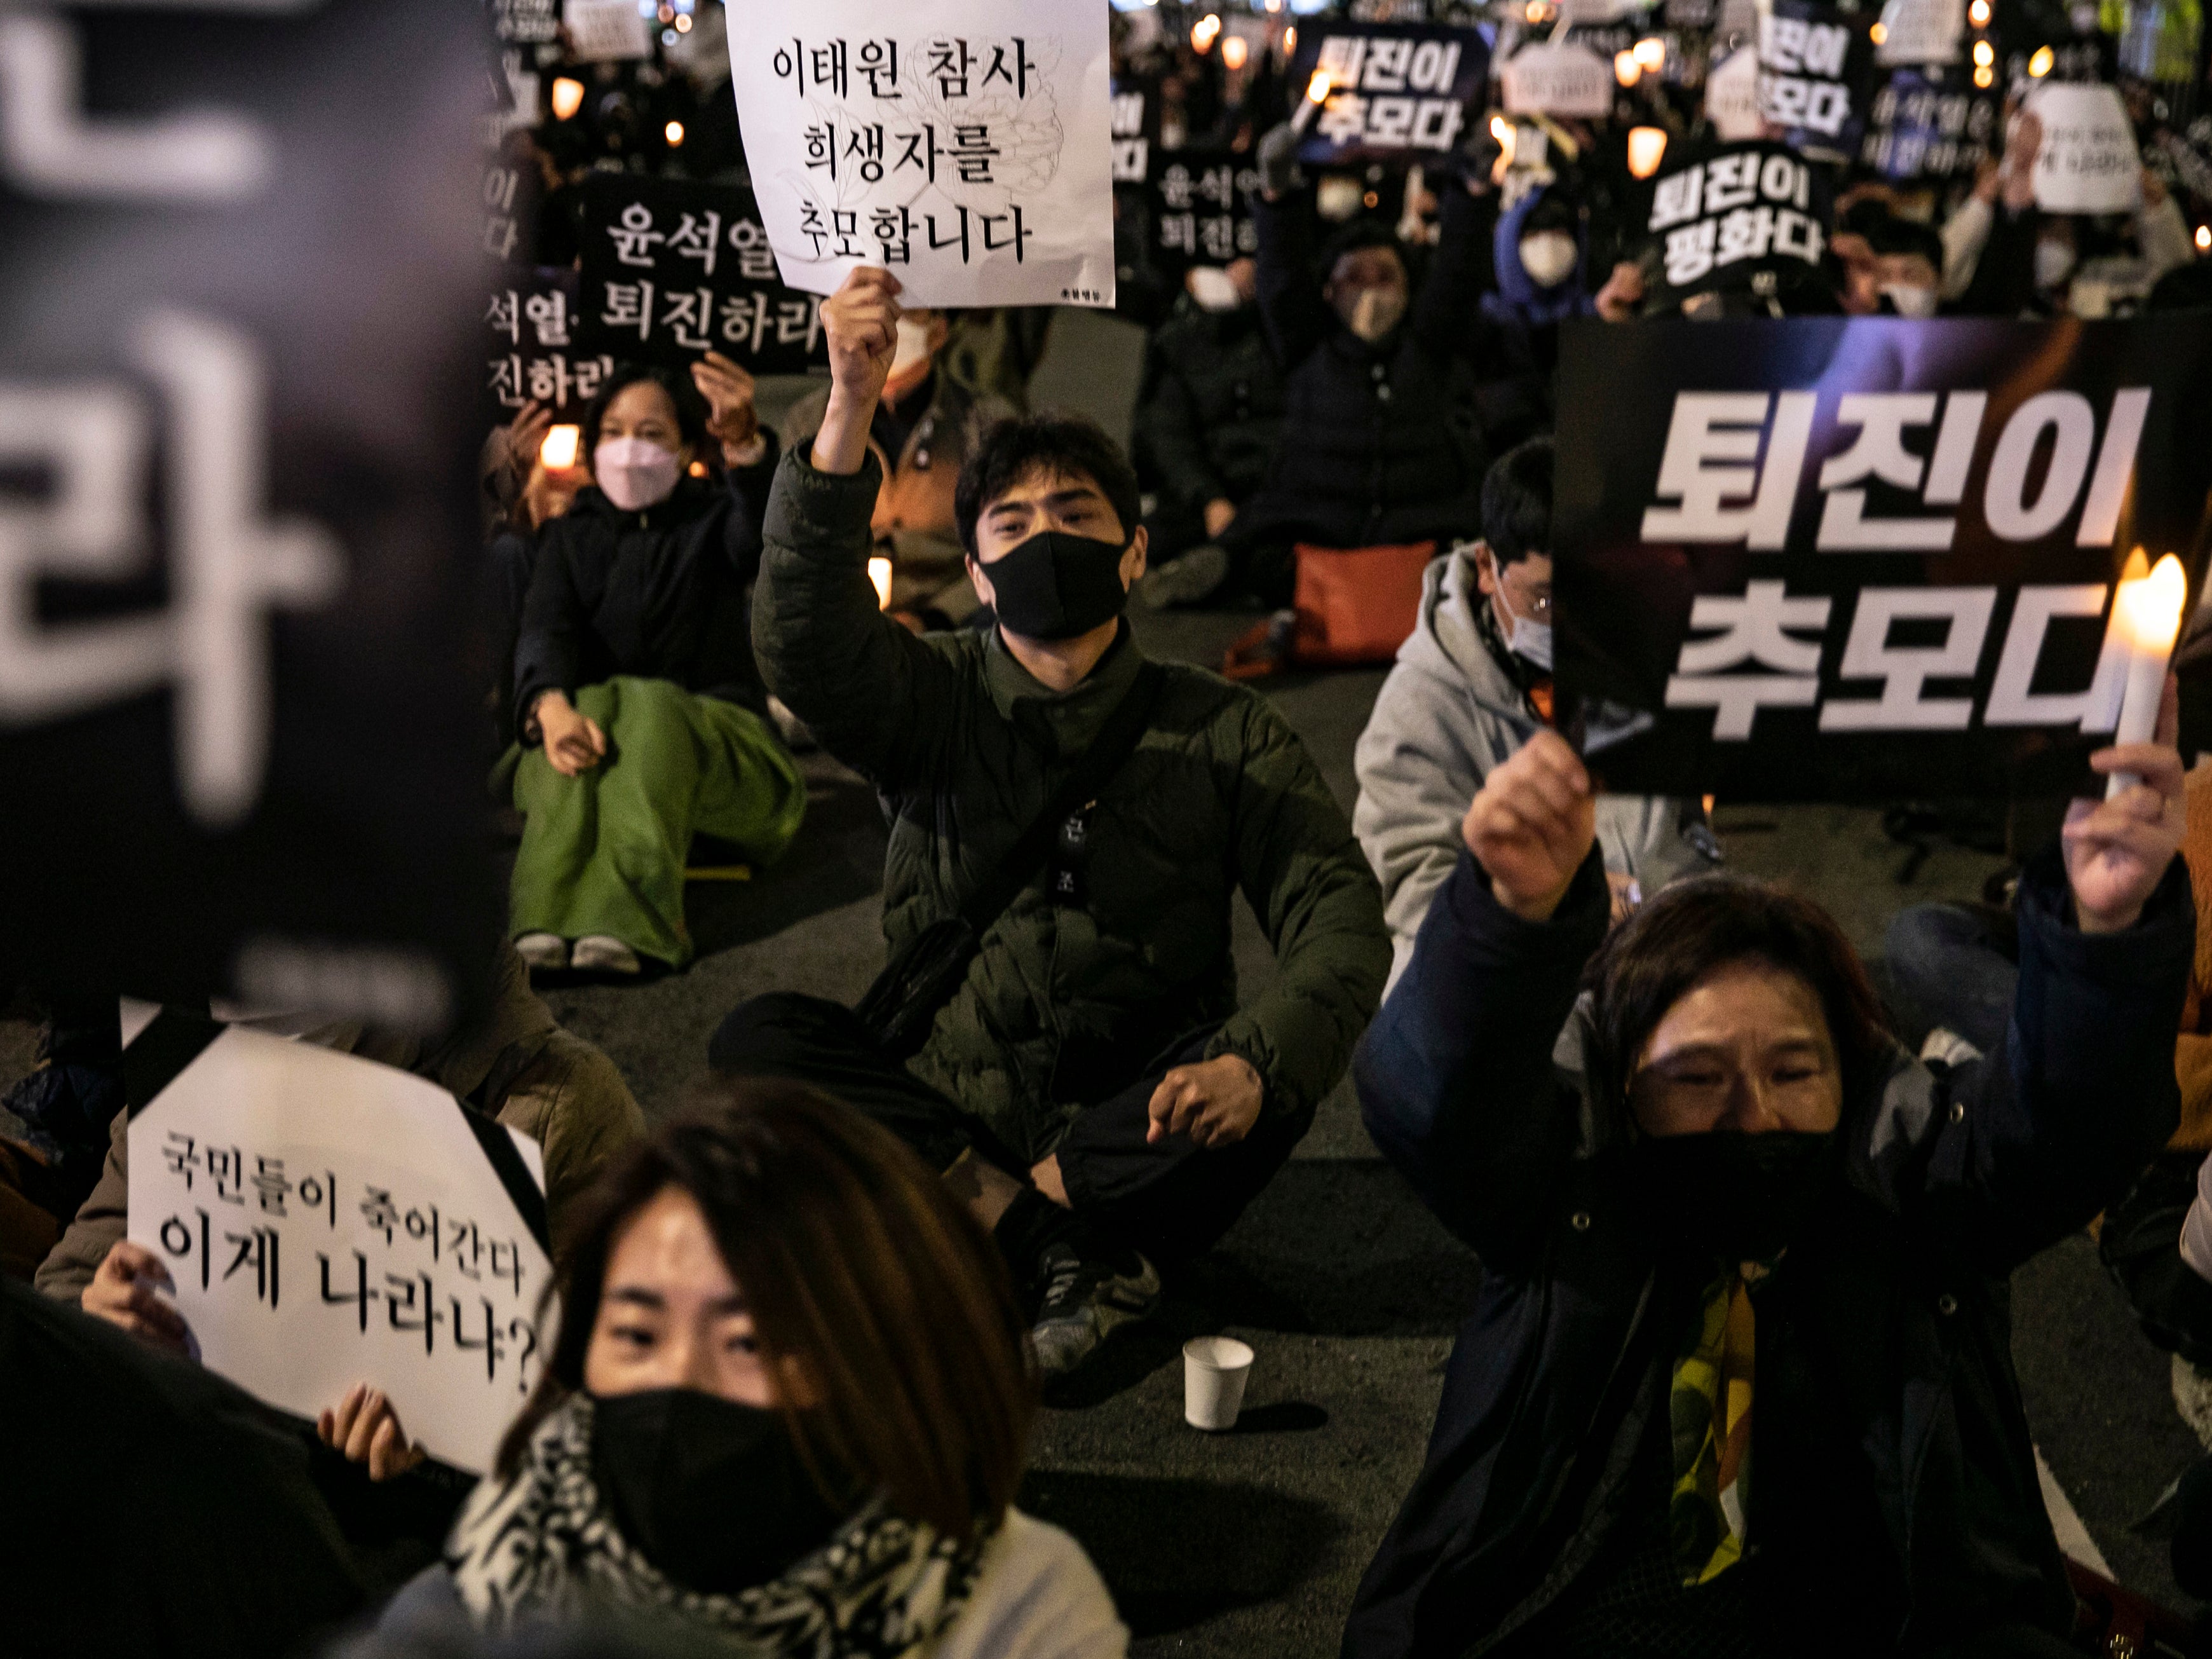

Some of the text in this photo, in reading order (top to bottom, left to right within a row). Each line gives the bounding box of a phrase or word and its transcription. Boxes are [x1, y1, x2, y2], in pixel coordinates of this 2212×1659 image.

[773, 36, 1036, 100] 이태원 참사
[1315, 36, 1462, 94] 퇴진이
[1761, 18, 1851, 79] 진이
[803, 121, 1001, 184] 희생자를
[1317, 93, 1465, 153] 추모다
[1650, 152, 1810, 233] 퇴진이
[607, 201, 777, 280] 윤석열
[800, 199, 1033, 265] 추모합니다
[1663, 206, 1825, 287] 평화다
[484, 289, 580, 346] 석열
[602, 279, 825, 354] 퇴진하라
[1639, 386, 2153, 552] 퇴진이
[1664, 577, 2130, 742] 추모다
[162, 1130, 526, 1298] 국민들이 죽어간다
[160, 1207, 537, 1395] 이게 나라냐?
